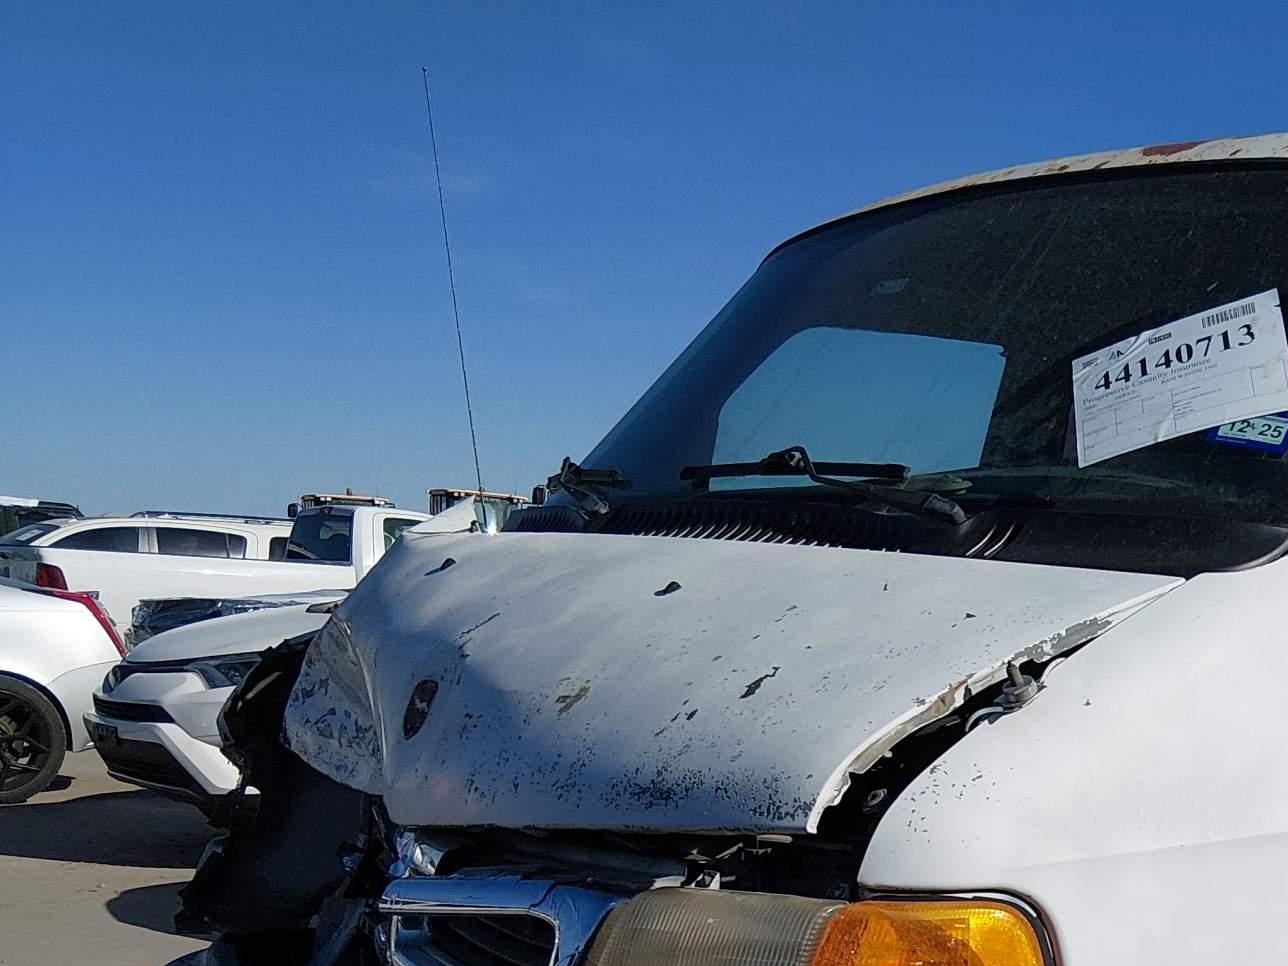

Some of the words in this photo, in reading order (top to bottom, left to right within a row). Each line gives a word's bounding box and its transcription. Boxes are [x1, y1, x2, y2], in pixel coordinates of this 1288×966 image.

[1094, 323, 1255, 391] 44140713
[1170, 357, 1211, 375] Insurance
[1228, 419, 1251, 434] 12
[1257, 423, 1284, 439] 25
